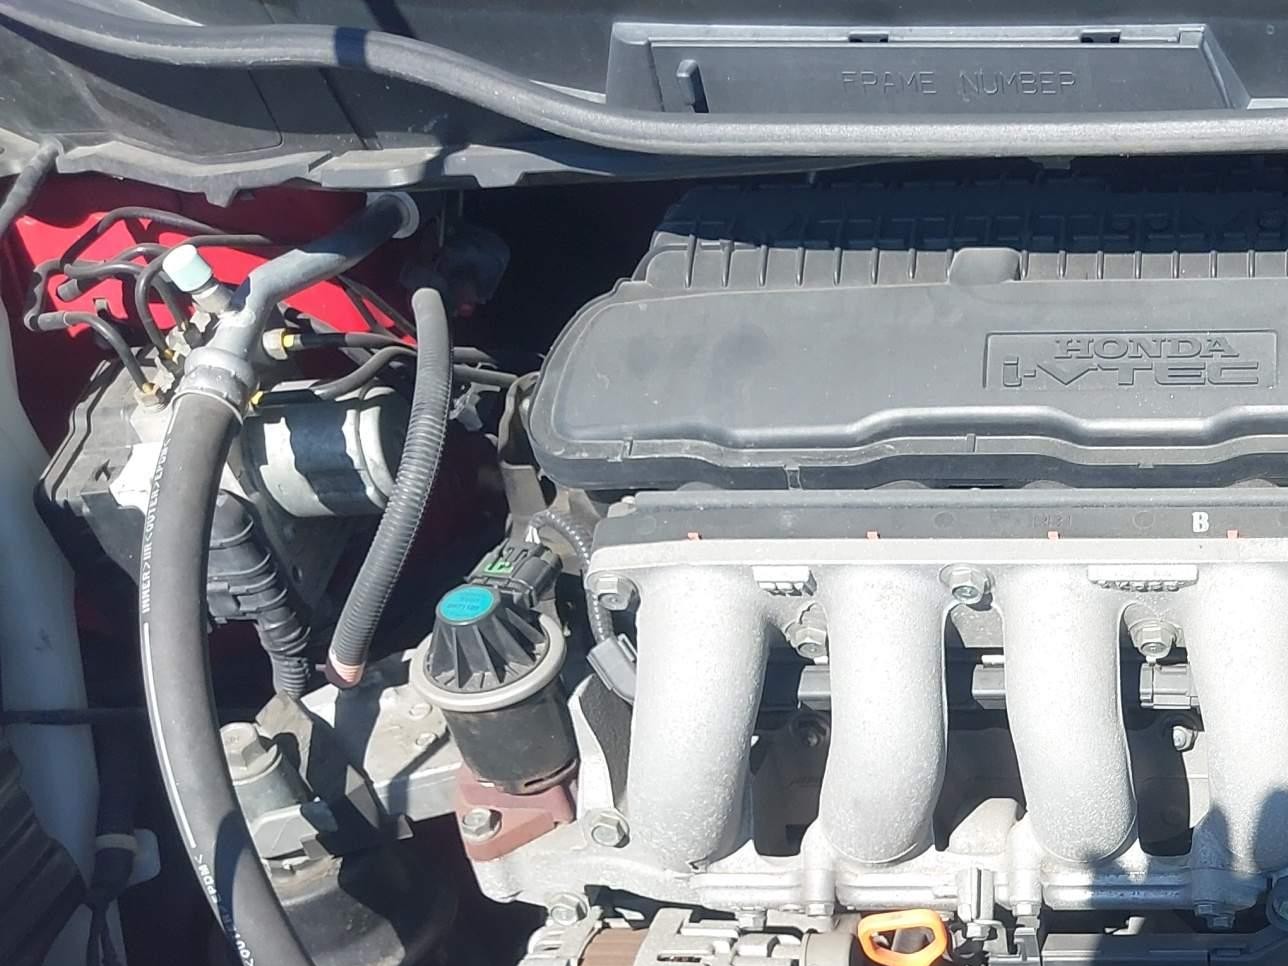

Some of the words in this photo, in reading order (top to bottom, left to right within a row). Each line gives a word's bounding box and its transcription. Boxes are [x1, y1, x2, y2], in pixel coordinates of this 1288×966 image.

[841, 71, 936, 95] FRAME
[959, 69, 1076, 95] NUMBER
[1053, 336, 1240, 359] HONDA
[1191, 511, 1210, 532] B
